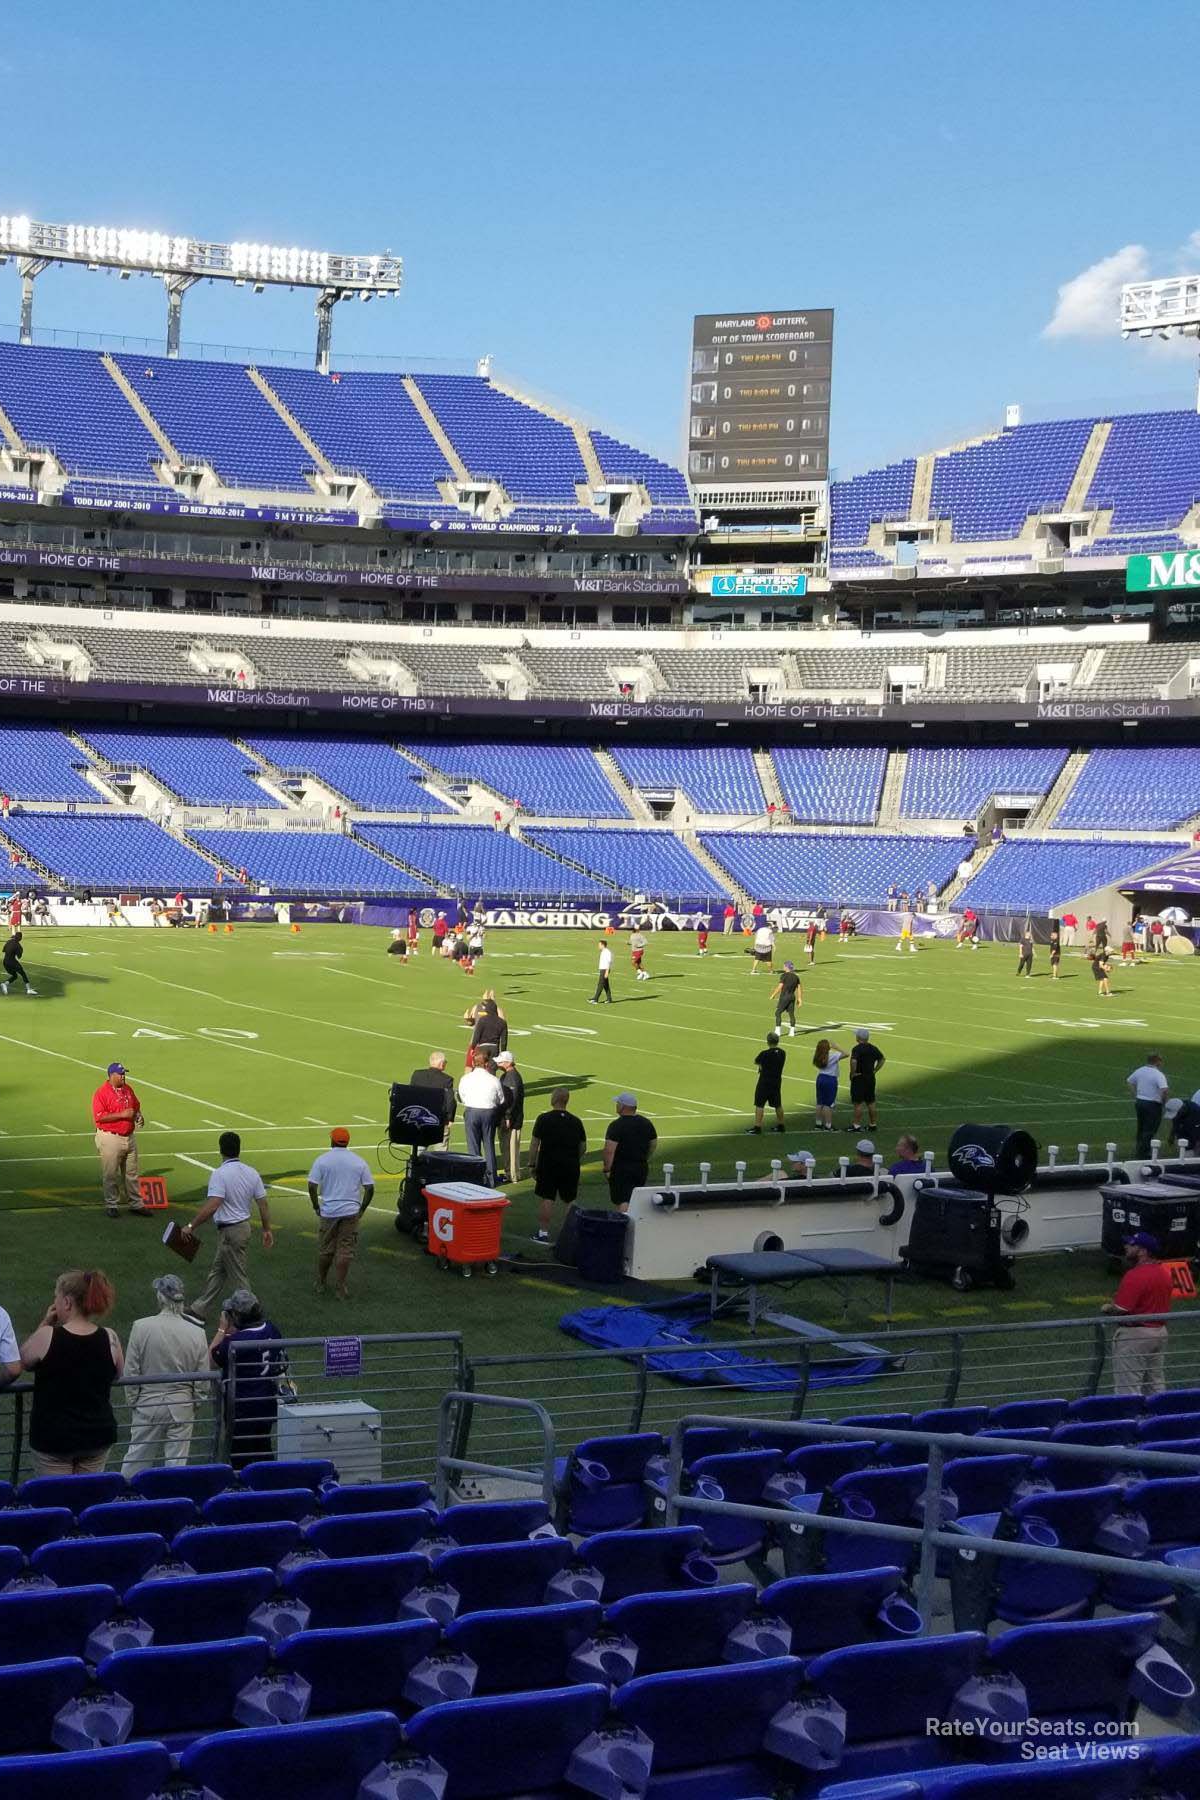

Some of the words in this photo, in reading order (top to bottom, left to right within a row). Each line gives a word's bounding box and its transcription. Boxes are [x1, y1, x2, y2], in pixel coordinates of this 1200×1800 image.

[715, 320, 755, 328] MARYLAND
[712, 335, 727, 343] OUT
[729, 335, 739, 343] OF
[742, 334, 764, 342] TOWN
[766, 331, 815, 341] SCOREBOARD
[725, 352, 733, 364] 0
[789, 350, 797, 362] 0
[724, 387, 731, 399] 0
[788, 384, 796, 397] 0
[723, 421, 731, 433] 0
[786, 419, 794, 431] 0
[721, 456, 729, 468] 0
[785, 454, 793, 466] 0
[0, 491, 34, 501] 1996-2012
[73, 497, 93, 506] TODD
[94, 499, 113, 507] HEAP
[114, 500, 151, 510] 2001-2010
[179, 505, 188, 513] ED
[190, 506, 208, 514] REED
[209, 507, 245, 517] 2002-2012
[275, 512, 313, 523] SMYTH
[471, 523, 496, 531] WORLD
[499, 524, 540, 532] CHAMPIONS
[545, 525, 563, 533] 2012
[40, 553, 73, 566] HOME
[77, 556, 94, 567] OF
[97, 557, 120, 569] THE
[251, 567, 278, 580] M&T
[279, 568, 304, 582] Bank
[305, 570, 348, 584] Stadium
[360, 573, 393, 585] HOME
[396, 575, 412, 586] OF
[415, 576, 438, 587] THE
[736, 576, 798, 585] STRATEGIC
[574, 579, 603, 592] M&T
[603, 580, 632, 592] Bank
[633, 580, 680, 593] Stadium
[736, 584, 799, 594] FACTORY
[0, 679, 16, 690] OF
[21, 679, 45, 692] THE
[207, 689, 236, 702] M&T
[237, 690, 263, 703] Bank
[265, 692, 309, 706] Stadium
[342, 696, 377, 708] HOME
[382, 698, 398, 709] OF
[590, 703, 621, 717] M&T
[622, 704, 652, 716] Bank
[654, 704, 704, 717] Stadium
[745, 705, 786, 717] HOME
[790, 705, 809, 717] OF
[814, 706, 840, 717] THE
[1037, 704, 1074, 718] M&T
[1075, 704, 1110, 717] Bank
[1112, 703, 1170, 717] Stadium
[141, 1182, 165, 1204] 30
[433, 1208, 453, 1241] G
